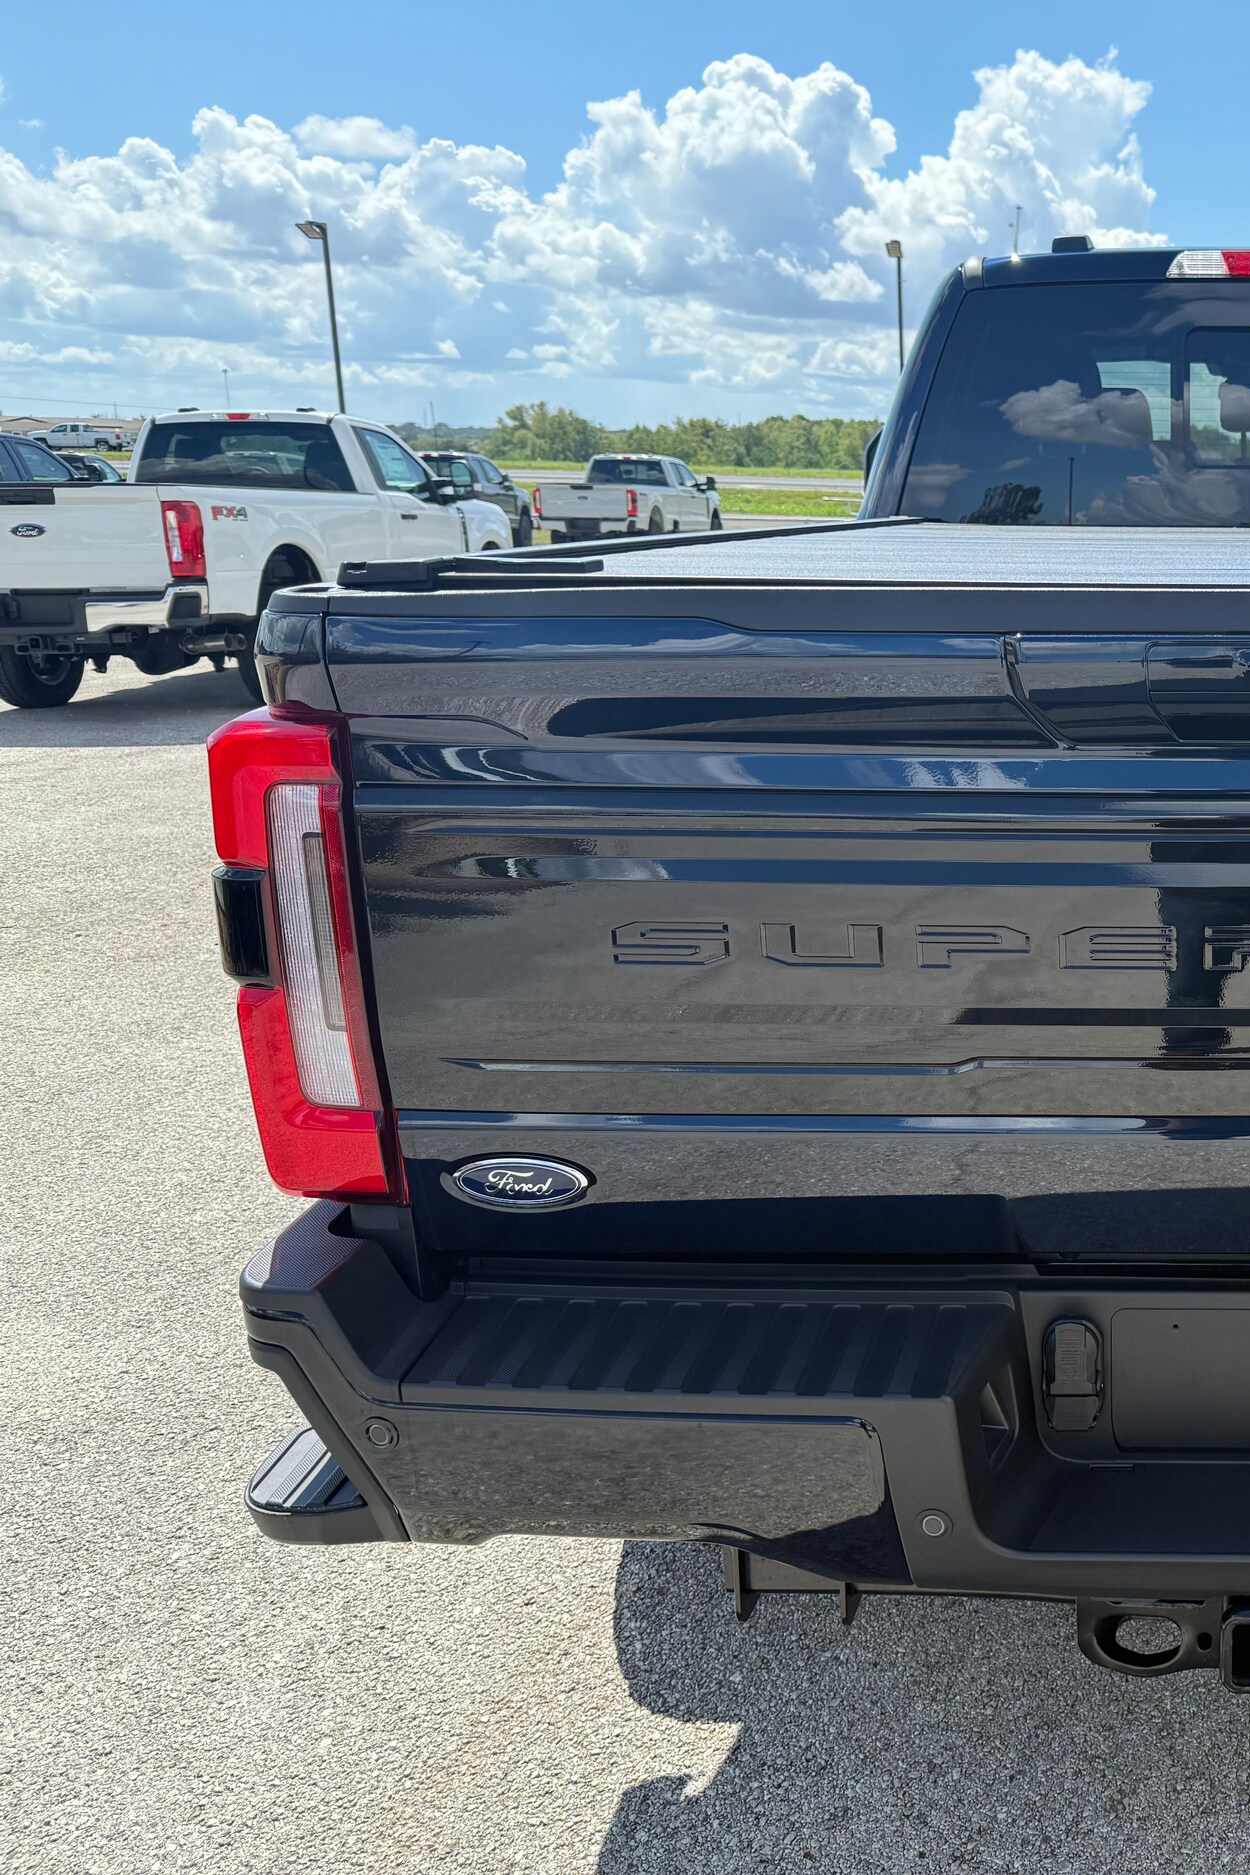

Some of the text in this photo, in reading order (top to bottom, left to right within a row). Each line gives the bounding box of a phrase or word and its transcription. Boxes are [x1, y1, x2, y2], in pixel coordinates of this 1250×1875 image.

[211, 505, 247, 520] FX4
[16, 526, 38, 535] Ford
[484, 1169, 553, 1195] Ford
